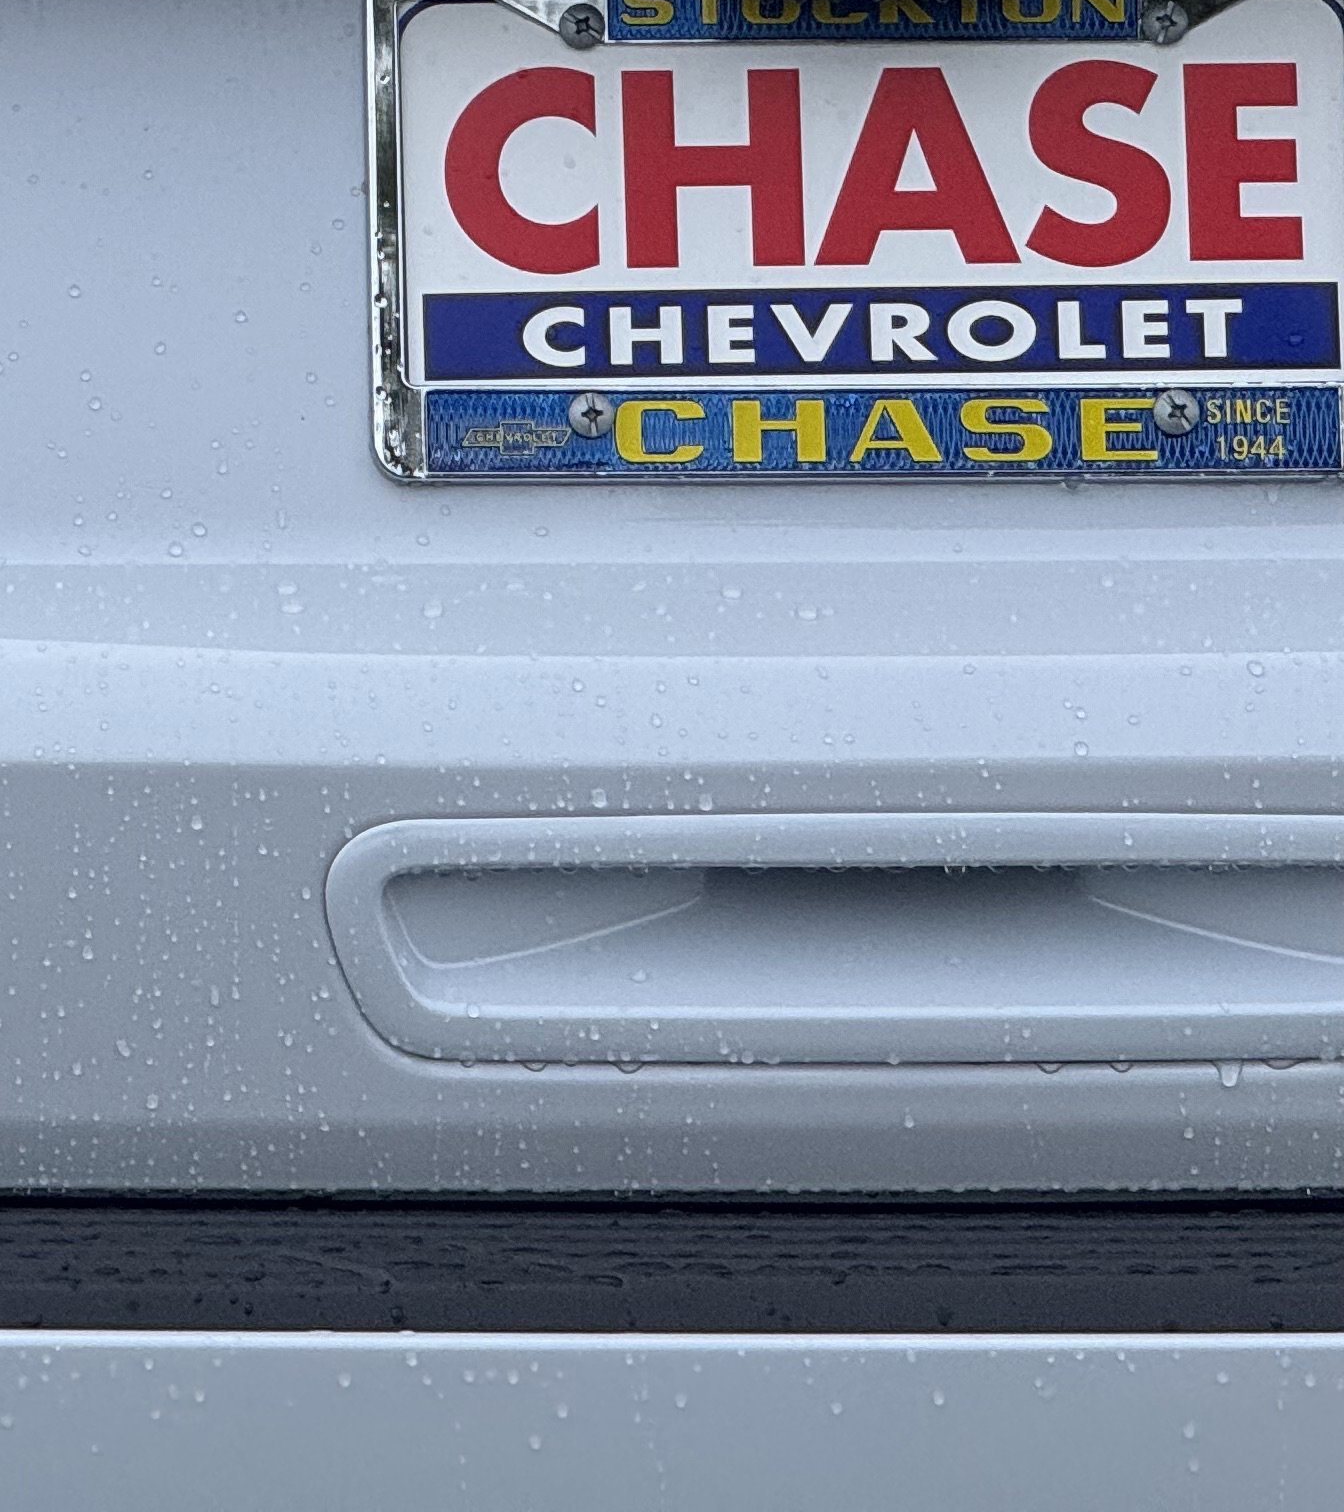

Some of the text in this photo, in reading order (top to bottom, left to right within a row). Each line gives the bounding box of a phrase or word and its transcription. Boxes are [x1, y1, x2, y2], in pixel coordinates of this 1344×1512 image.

[444, 59, 1304, 275] CHASE
[521, 297, 1243, 368] CHEVROLET
[614, 397, 1159, 465] CHASE
[1206, 398, 1291, 425] SINCE
[475, 431, 558, 444] CHEVROLET
[1216, 435, 1286, 461] 1944
